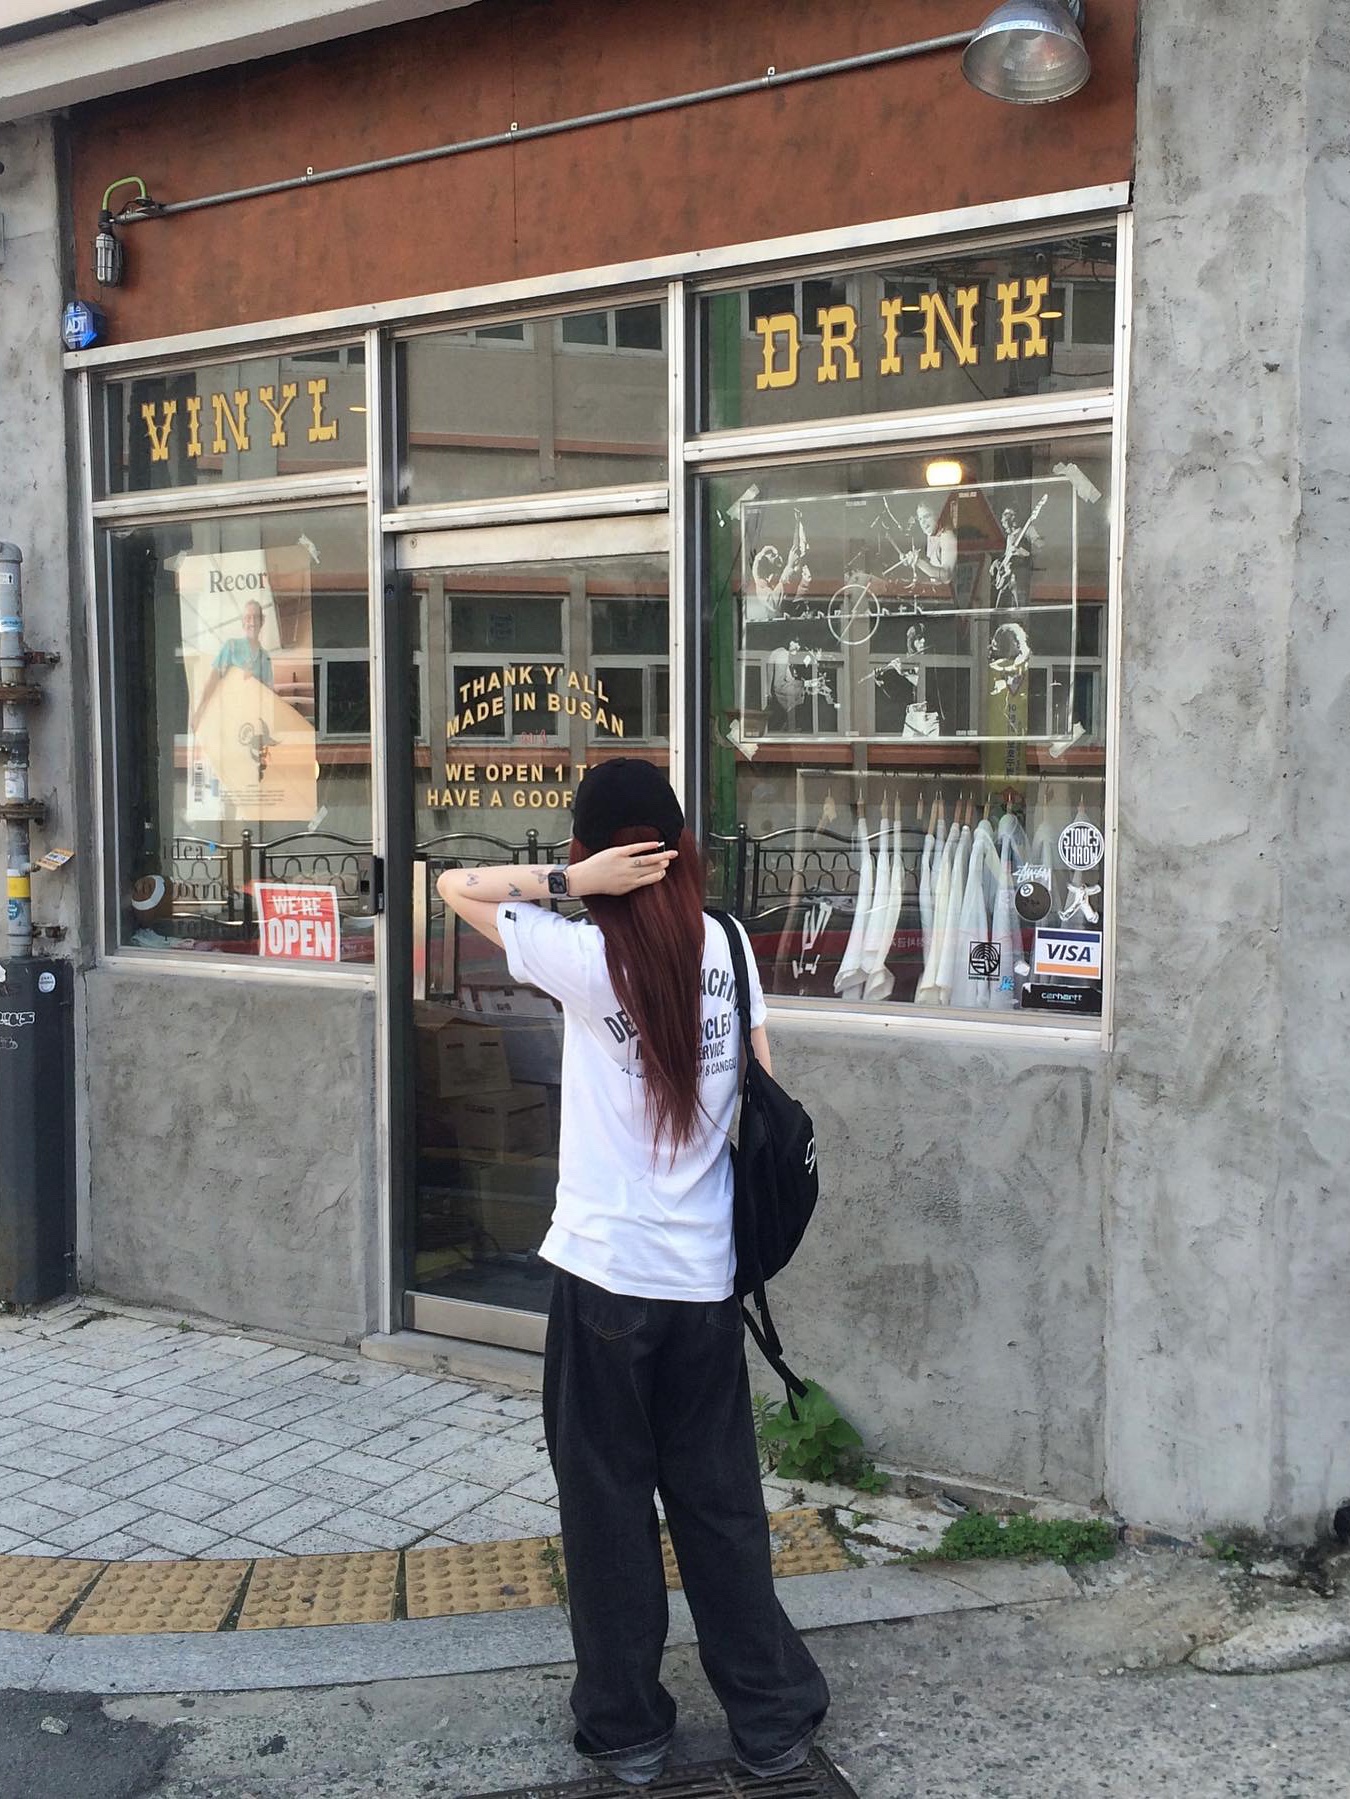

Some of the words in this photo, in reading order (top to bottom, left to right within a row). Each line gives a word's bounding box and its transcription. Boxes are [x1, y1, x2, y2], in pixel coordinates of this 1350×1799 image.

[66, 315, 87, 335] ADT
[754, 276, 1050, 390] DRINK
[141, 378, 338, 462] VINYL
[209, 570, 267, 594] Recor
[459, 665, 534, 704] THANK
[543, 665, 610, 703] Y'ALL
[446, 696, 505, 739] MADE
[514, 691, 536, 712] IN
[547, 692, 625, 738] BUSAN
[445, 763, 476, 782] WE
[485, 763, 544, 782] OPEN
[554, 763, 564, 782] 1
[427, 788, 481, 807] HAVE
[490, 789, 503, 807] A
[1063, 827, 1099, 847] STONES
[1064, 845, 1099, 865] THROW
[271, 894, 323, 917] WE'RE
[267, 916, 333, 958] OPEN
[1047, 942, 1092, 963] VISA
